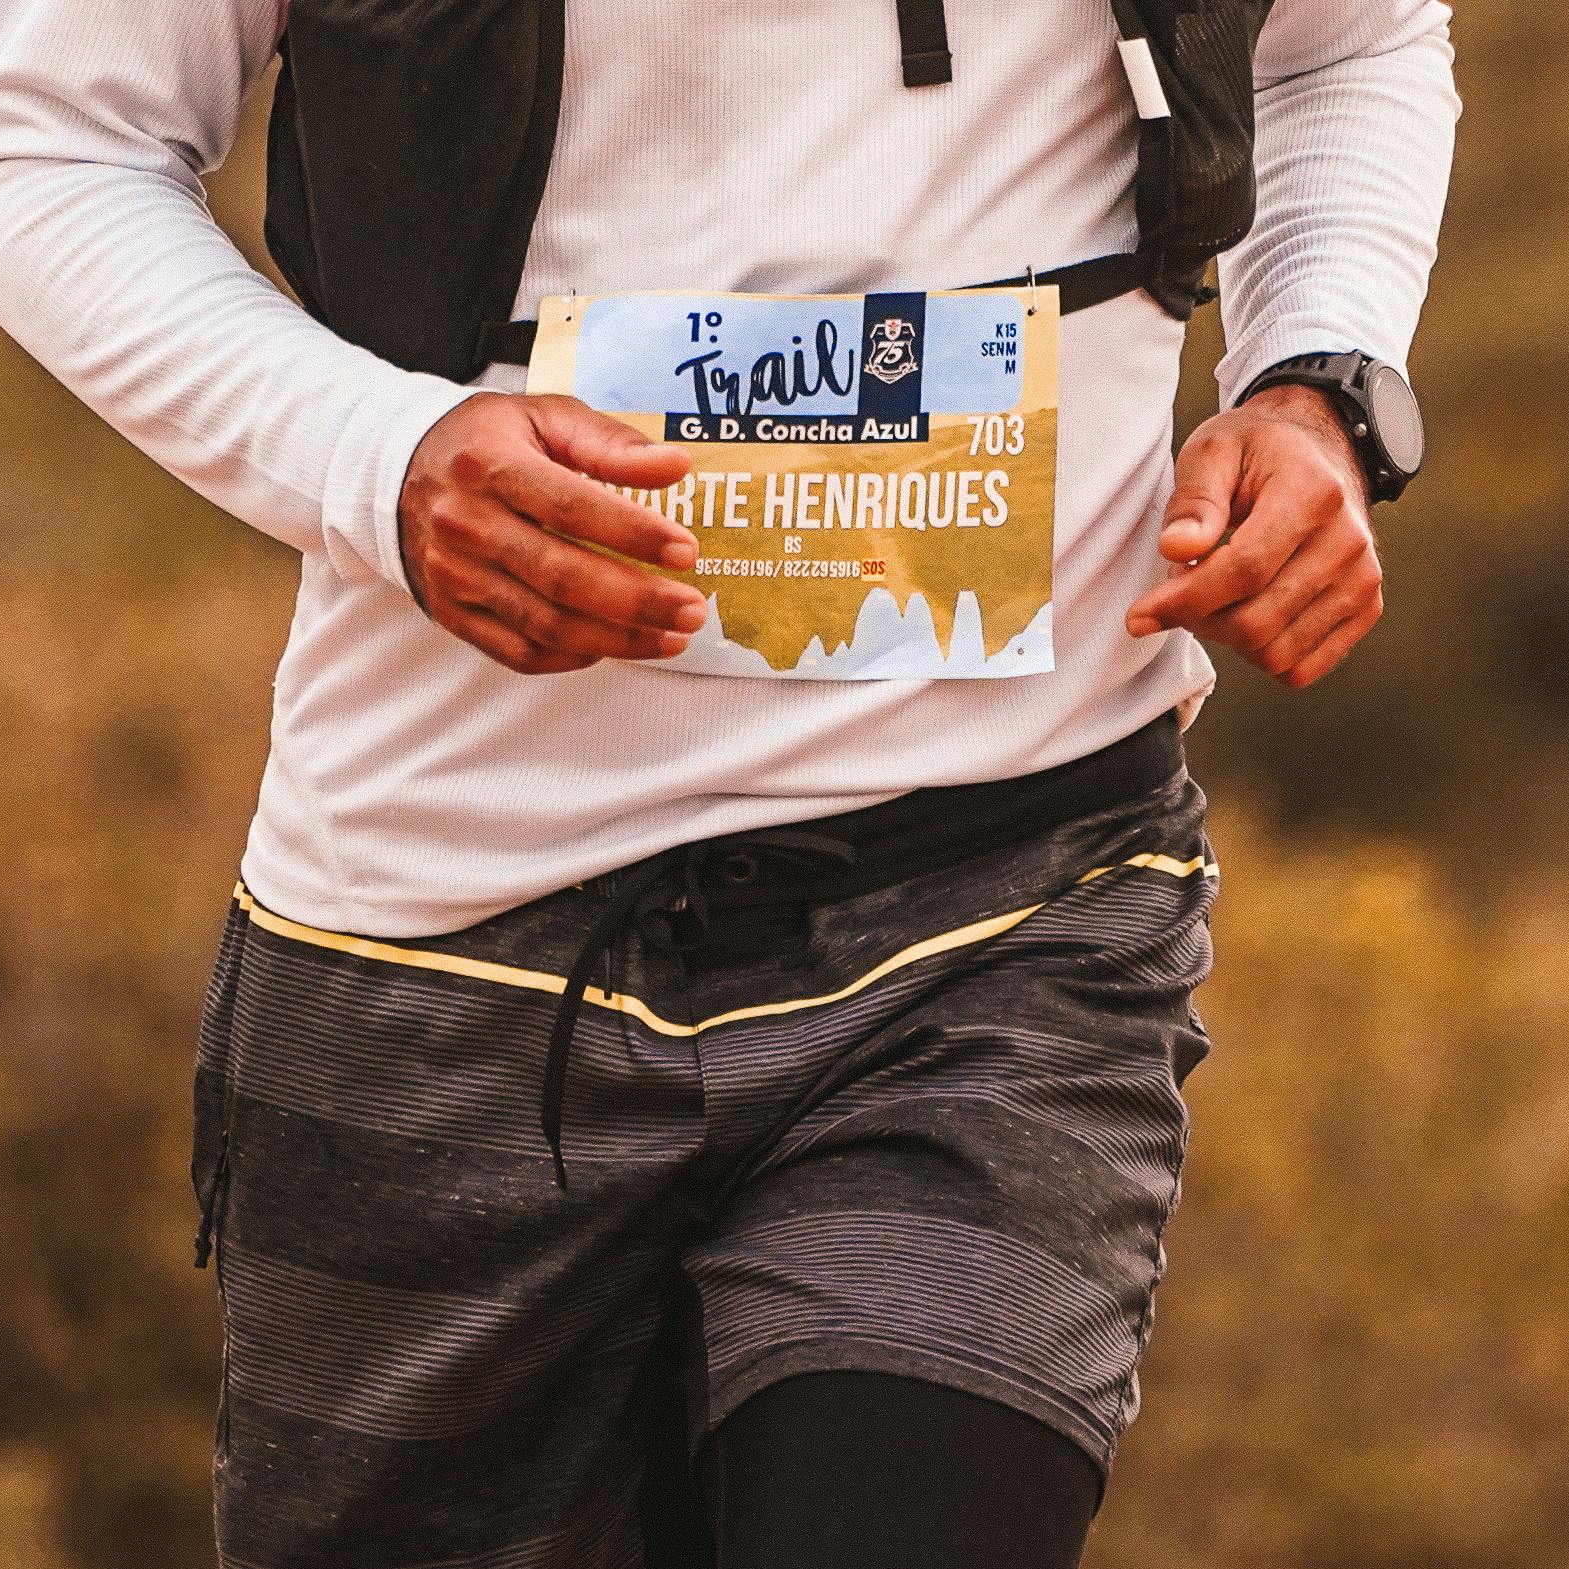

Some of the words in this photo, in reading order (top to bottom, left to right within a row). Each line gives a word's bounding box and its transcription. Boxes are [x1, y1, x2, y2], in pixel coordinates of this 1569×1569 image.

[877, 340, 907, 364] 75
[675, 319, 854, 416] Trail
[1004, 359, 1016, 374] M
[680, 417, 708, 440] G.
[719, 418, 745, 440] D.
[755, 418, 853, 441] Concha
[860, 415, 918, 441] Azul
[966, 414, 1025, 456] 703
[763, 469, 1010, 531] HENRIQUES
[862, 560, 885, 576] SOS
